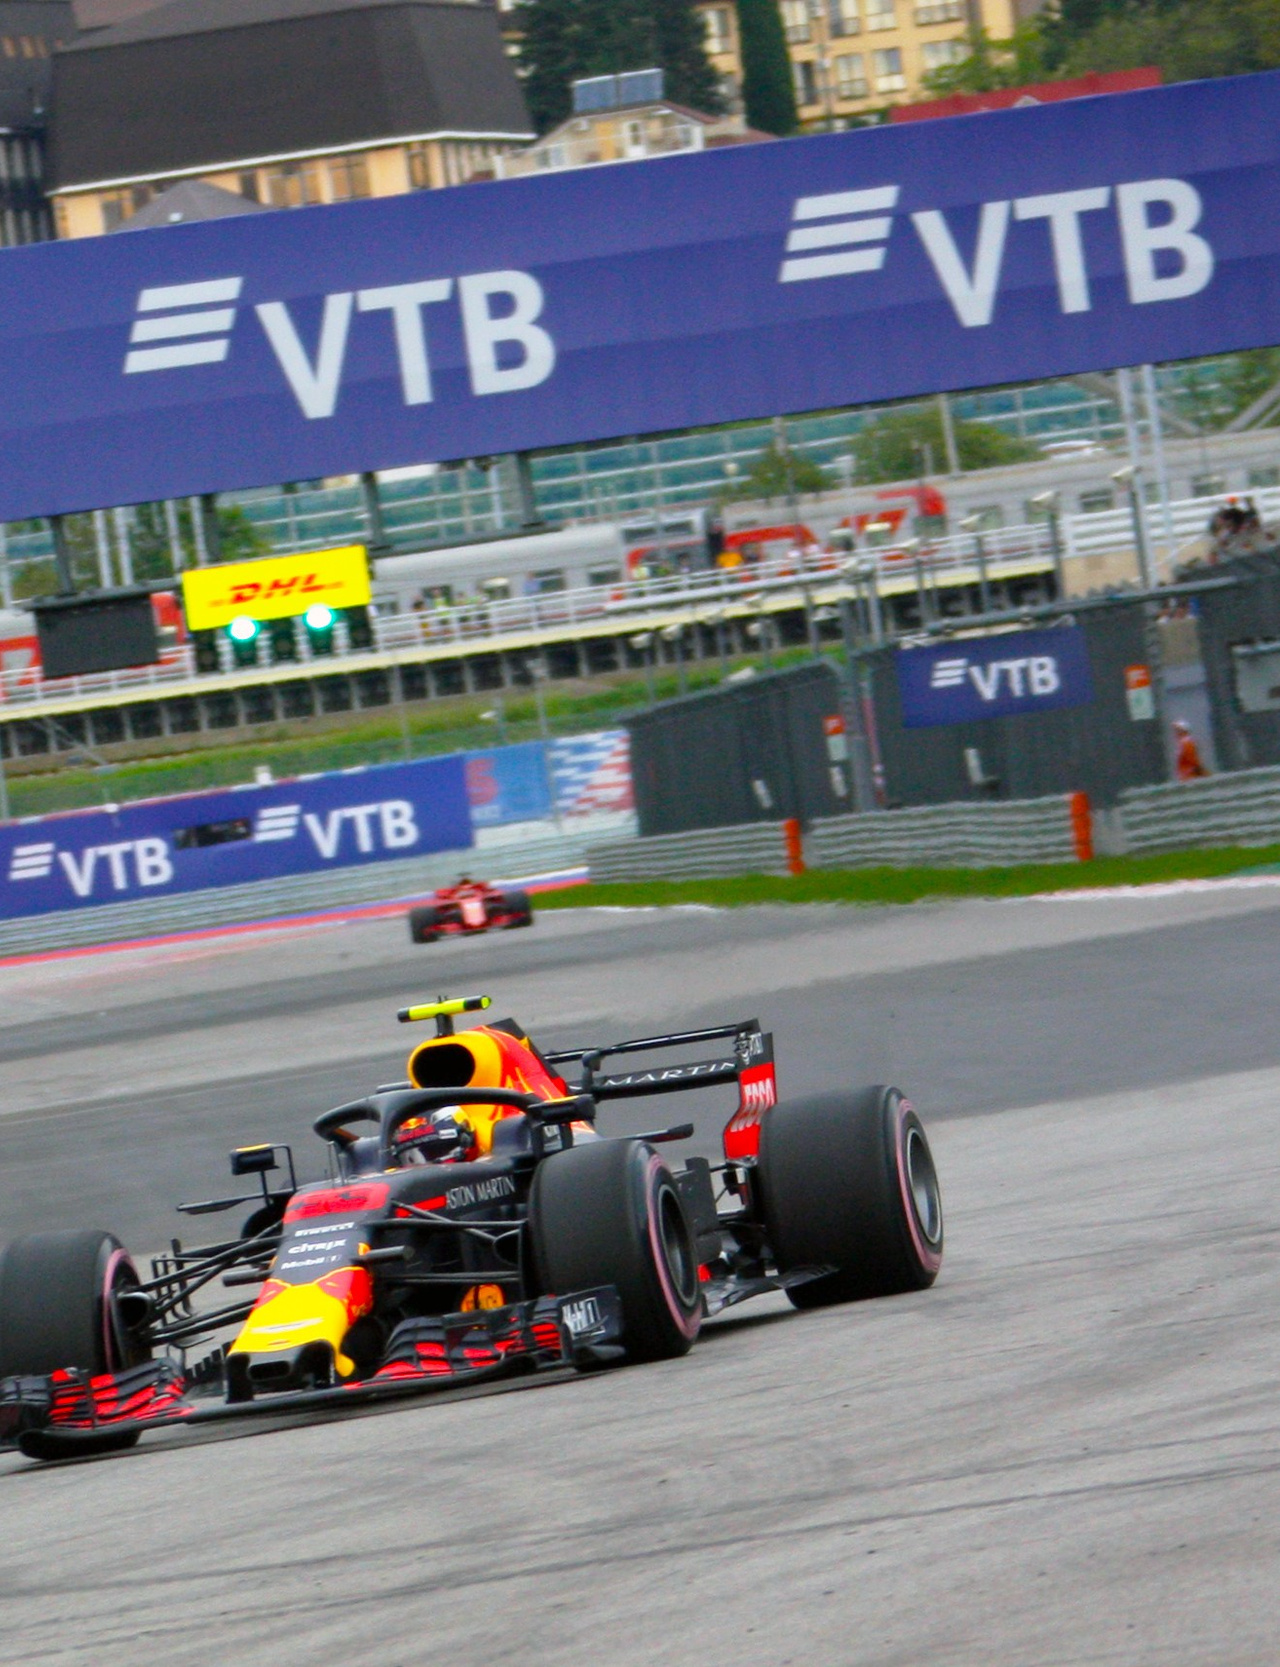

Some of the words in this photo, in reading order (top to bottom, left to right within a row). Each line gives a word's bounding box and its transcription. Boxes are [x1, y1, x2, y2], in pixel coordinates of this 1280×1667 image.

[912, 179, 1213, 326] VTB
[254, 270, 556, 419] VTB
[228, 573, 326, 605] DHL
[969, 656, 1061, 702] VTB
[303, 799, 419, 859] VTB
[57, 836, 174, 898] VTB
[446, 1185, 476, 1209] ASTON
[476, 1176, 516, 1202] MARTIN
[281, 1256, 325, 1270] Mobil
